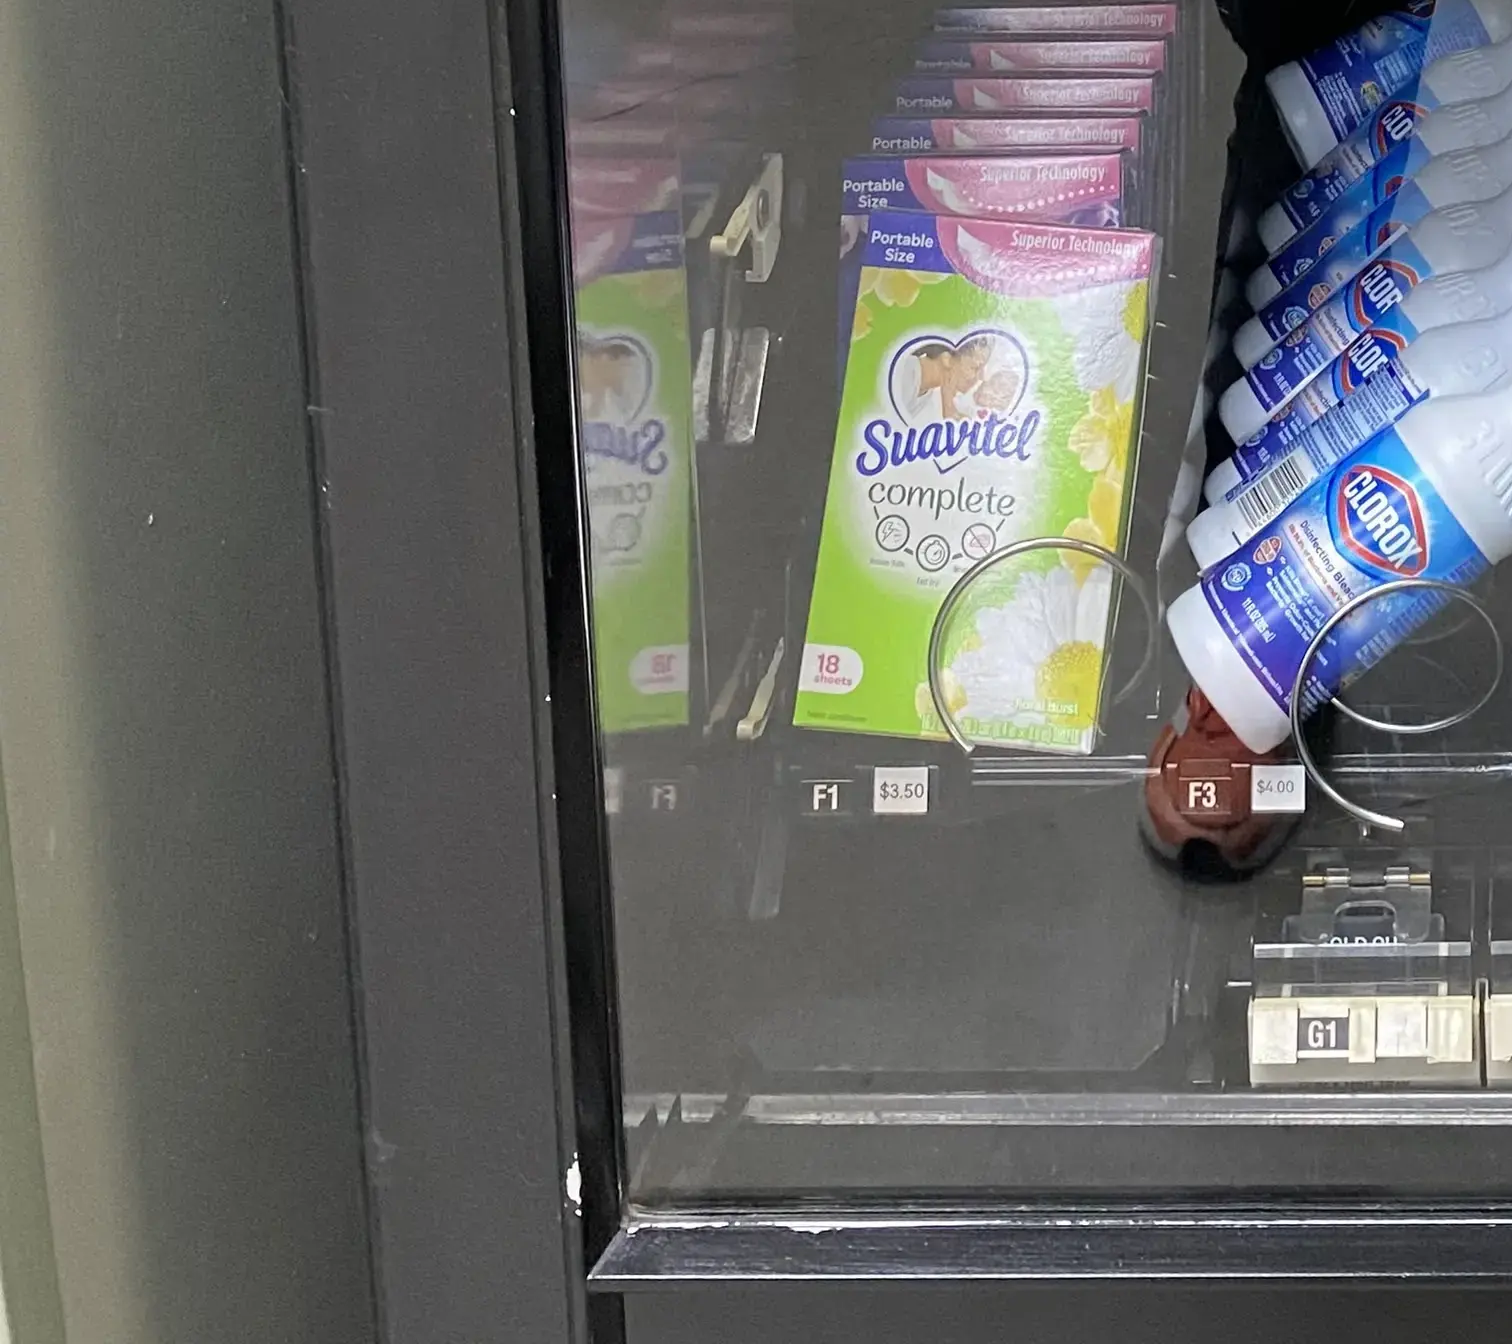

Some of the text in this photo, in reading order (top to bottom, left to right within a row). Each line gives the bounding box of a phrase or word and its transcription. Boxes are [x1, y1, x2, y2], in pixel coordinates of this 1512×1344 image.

[872, 136, 932, 150] Portable
[842, 164, 1106, 193] Portable Superior Technology
[857, 194, 888, 209] Size
[871, 229, 934, 249] Portable
[1011, 230, 1066, 253] Superior
[884, 249, 915, 263] Size
[856, 410, 1041, 477] Suavitel
[867, 477, 1016, 521] complete
[1343, 470, 1425, 571] CLOROX
[1300, 519, 1335, 574] Disinfecting
[817, 653, 840, 674] 18
[813, 673, 853, 687] sheets
[813, 784, 839, 811] F1
[879, 782, 925, 800] $3.50
[1188, 781, 1216, 809] F3
[1255, 779, 1296, 796] $4.00
[1307, 1020, 1338, 1049] G1
